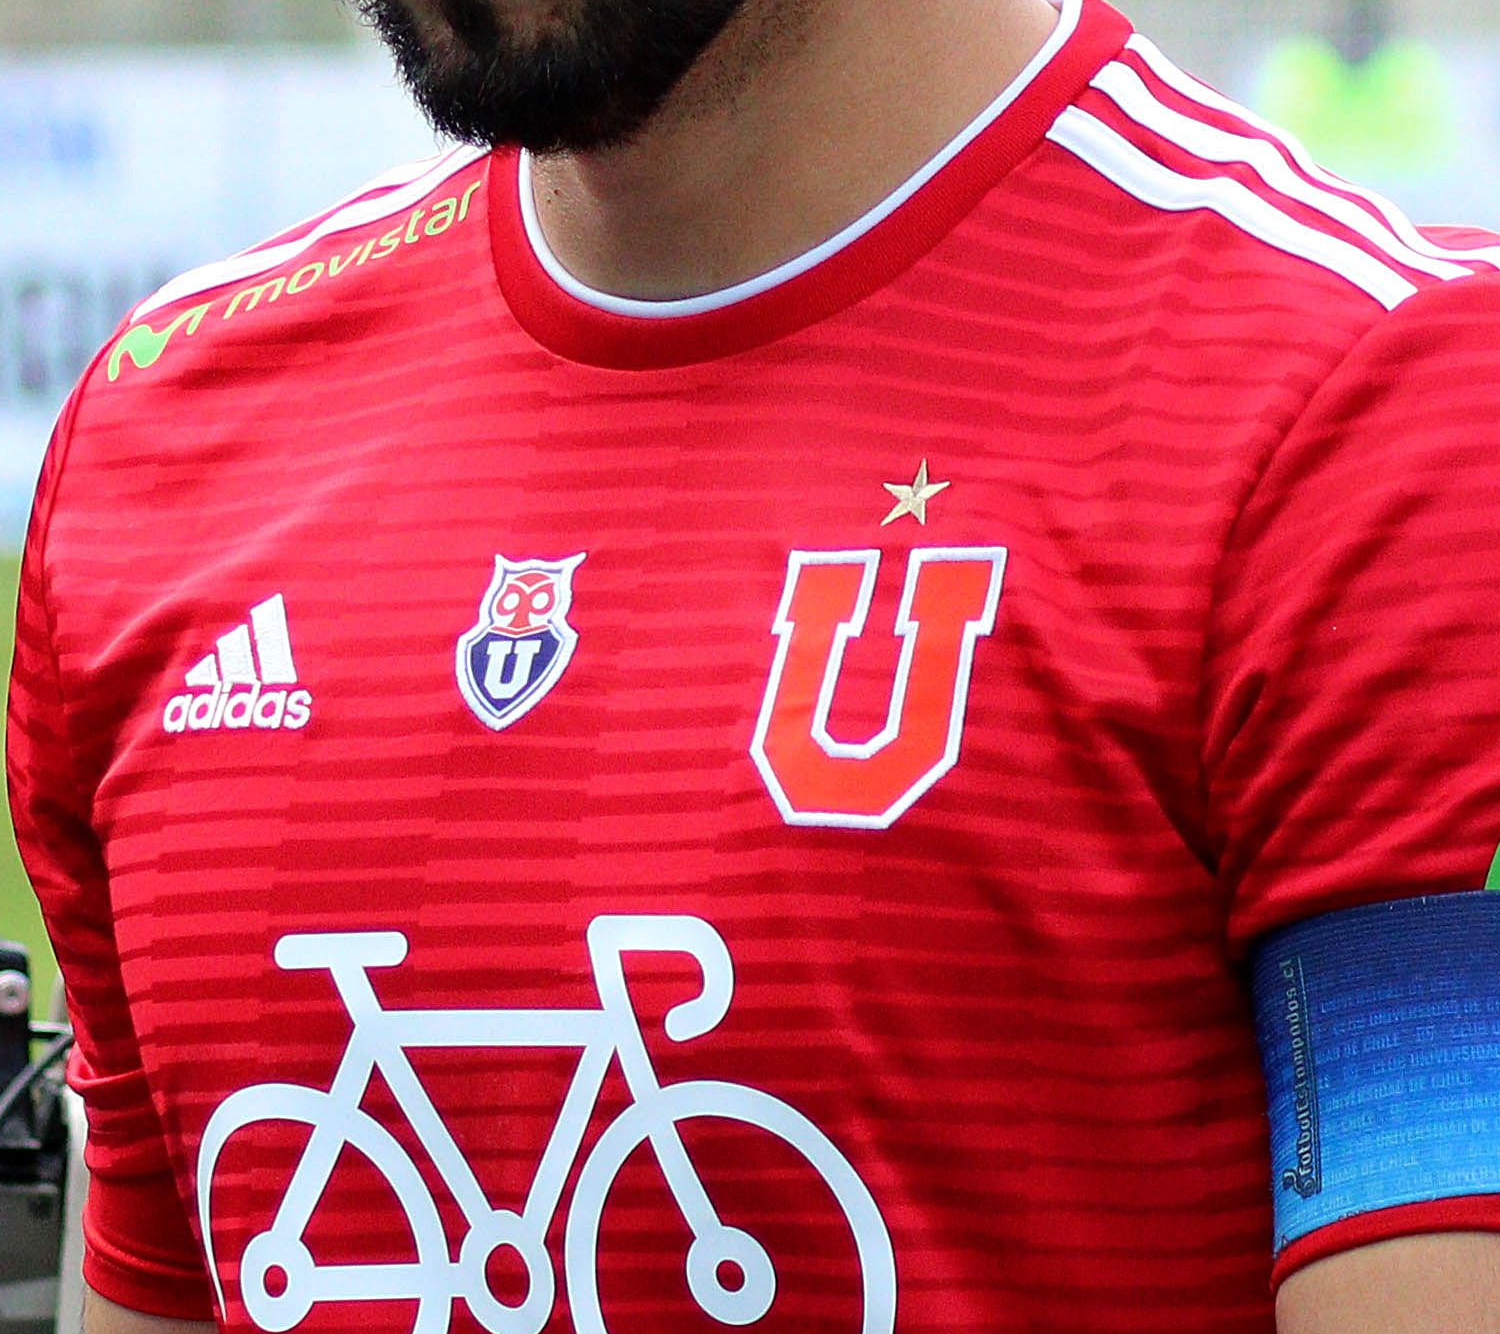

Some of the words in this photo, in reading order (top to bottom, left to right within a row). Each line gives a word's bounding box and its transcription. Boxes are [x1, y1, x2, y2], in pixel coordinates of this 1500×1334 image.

[222, 180, 483, 321] movistar
[162, 681, 313, 734] adidas
[485, 637, 543, 701] U
[748, 546, 1008, 831] U
